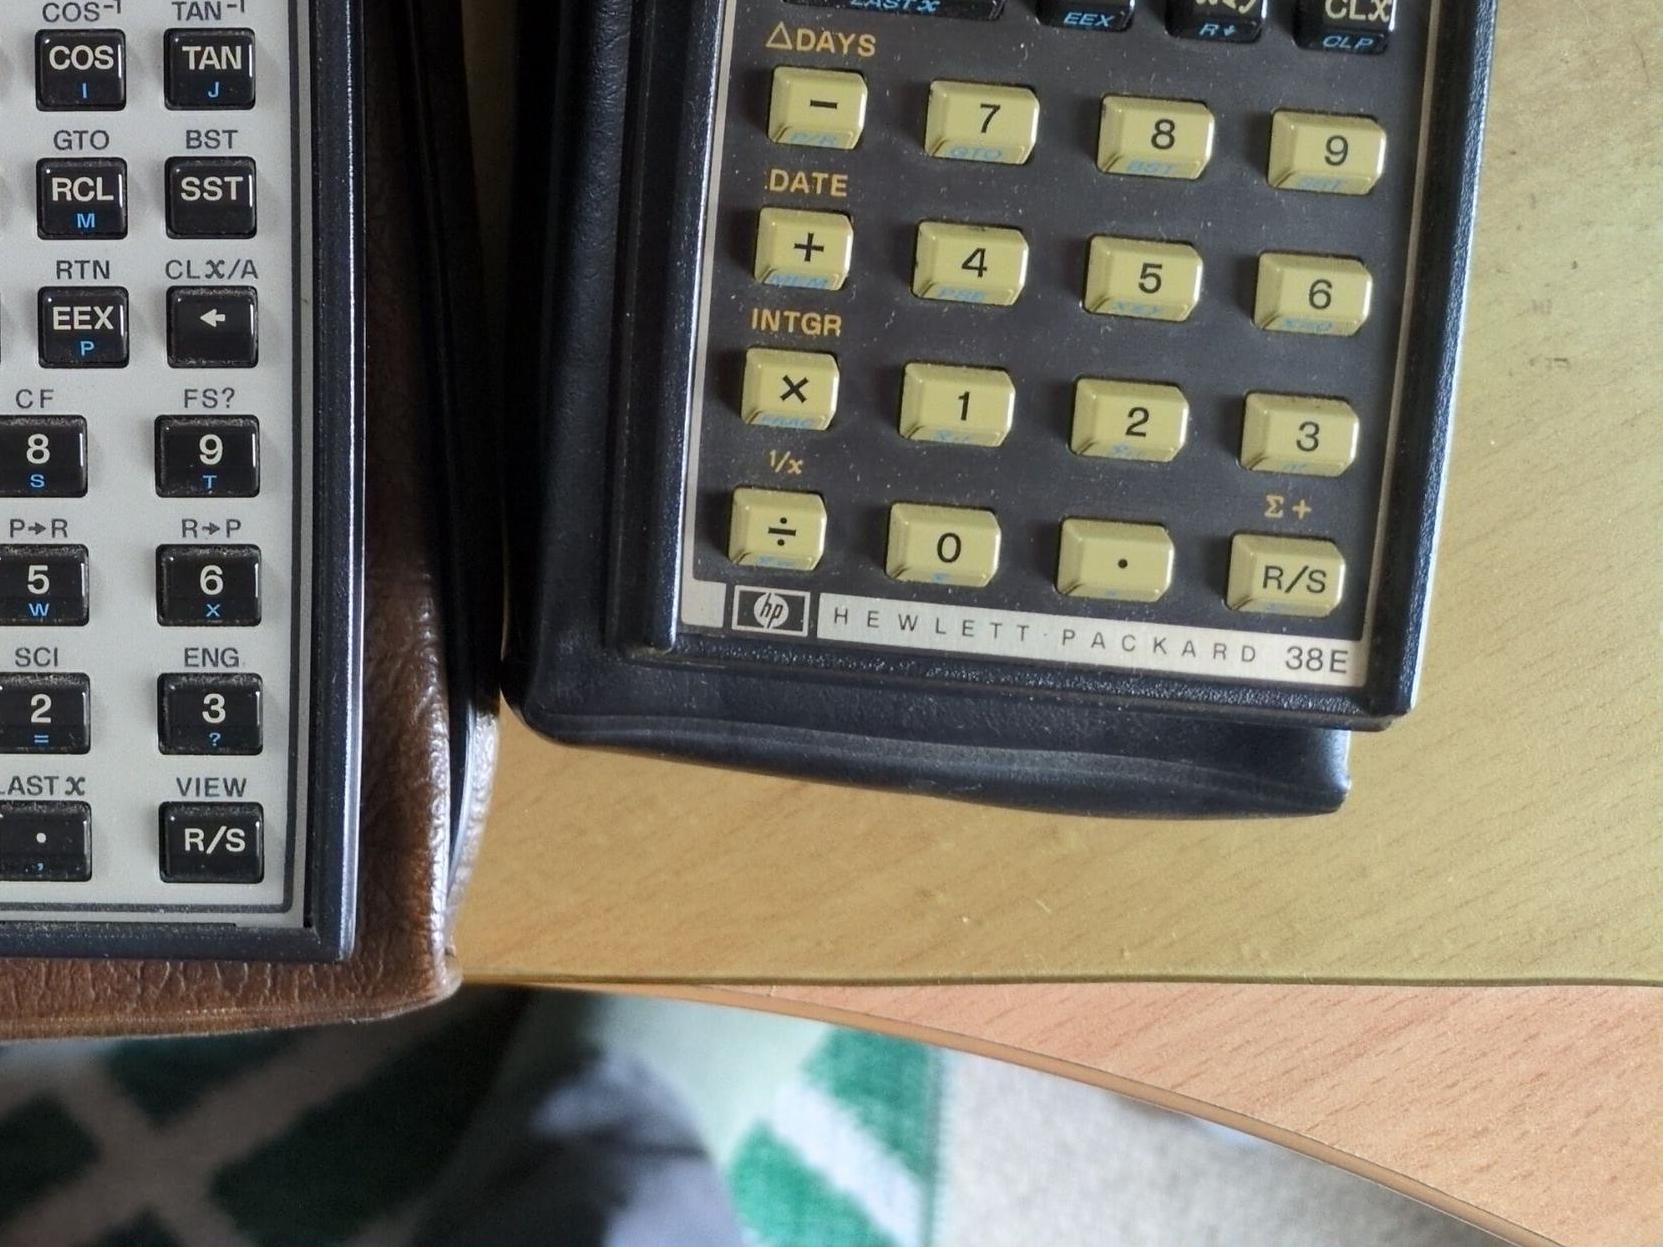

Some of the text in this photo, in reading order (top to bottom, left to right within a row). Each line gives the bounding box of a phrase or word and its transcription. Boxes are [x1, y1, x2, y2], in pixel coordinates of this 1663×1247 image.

[1063, 13, 1114, 27] EEX
[1323, 36, 1374, 49] CLP
[49, 46, 114, 70] COS
[182, 46, 242, 70] TAN
[980, 104, 1000, 133] 7
[54, 130, 110, 150] GTO
[186, 130, 238, 149] BST
[1151, 119, 1176, 149] 8
[1324, 135, 1349, 166] 9
[52, 177, 114, 201] RCL
[180, 176, 243, 201] SST
[769, 169, 849, 197] DATE
[56, 260, 110, 280] RTN
[961, 248, 987, 278] 4
[1139, 263, 1162, 293] 5
[1308, 279, 1333, 310] 6
[52, 307, 114, 330] EEX
[752, 309, 842, 336] INTGR
[958, 391, 970, 421] 1
[1125, 407, 1150, 437] 2
[1296, 421, 1320, 451] 3
[937, 533, 961, 563] 0
[1262, 566, 1327, 593] R/S
[15, 647, 59, 667] SCI
[184, 647, 239, 667] ENG
[1285, 646, 1348, 674] 38E
[176, 777, 247, 797] VIEW
[184, 825, 245, 854] R/S
